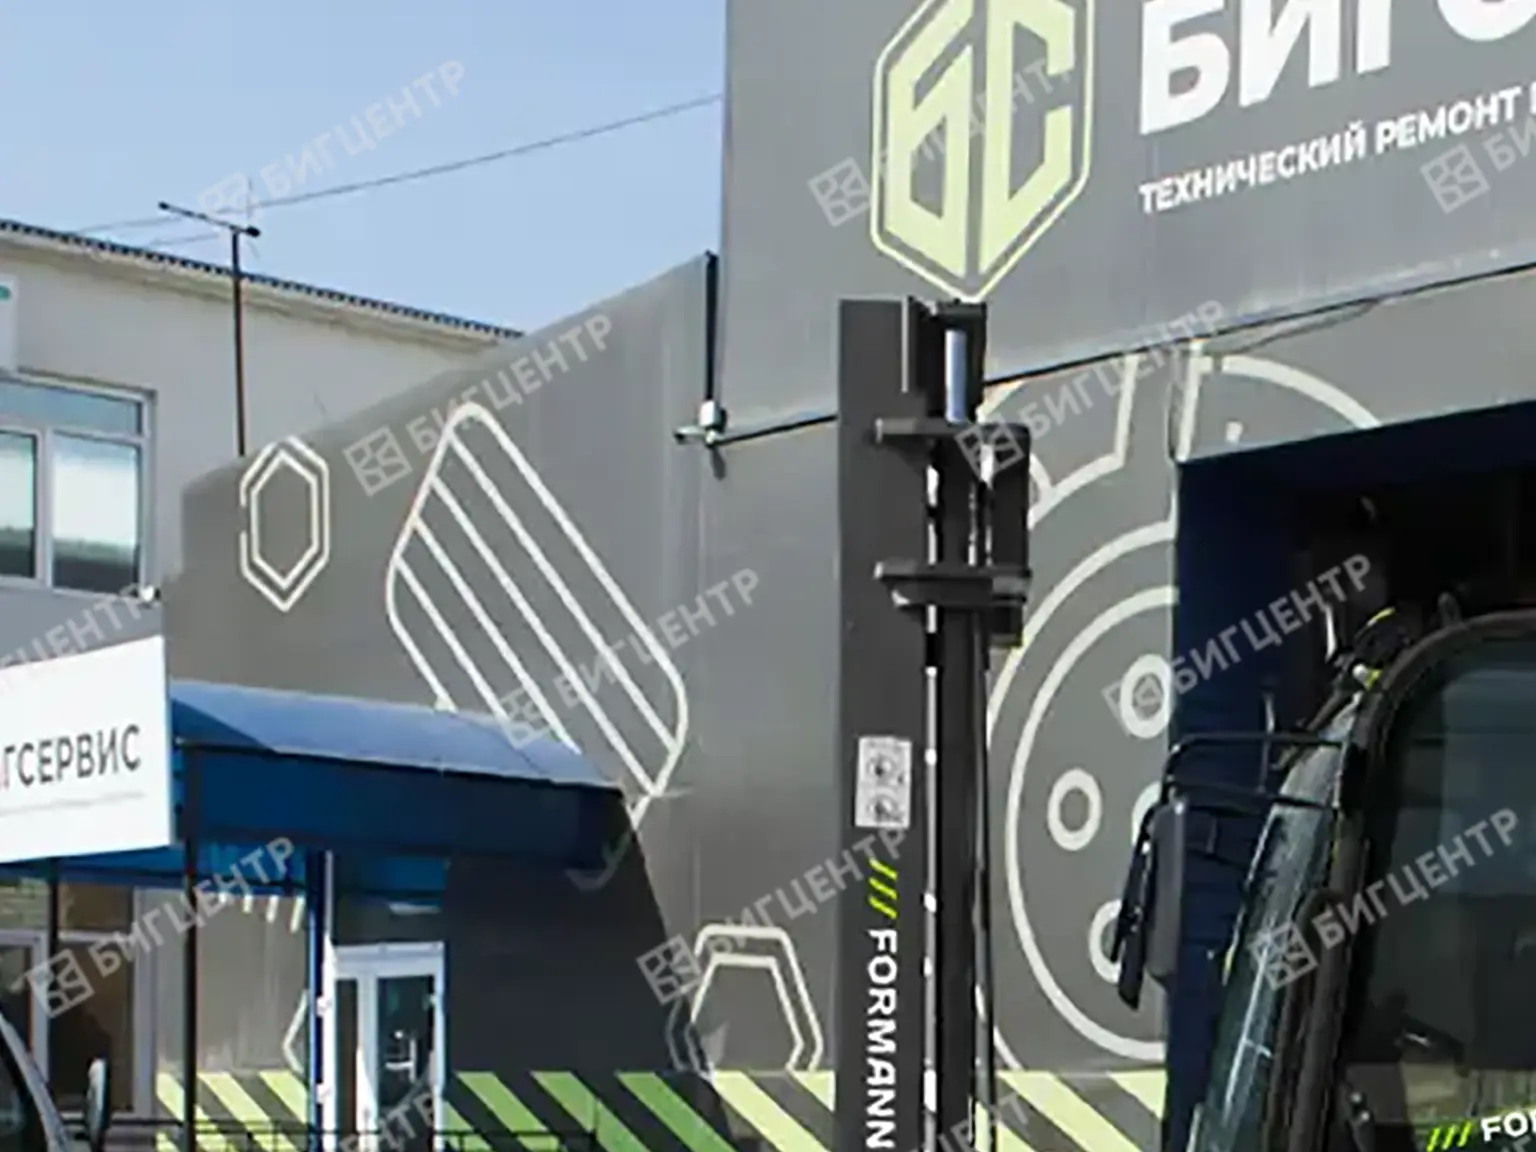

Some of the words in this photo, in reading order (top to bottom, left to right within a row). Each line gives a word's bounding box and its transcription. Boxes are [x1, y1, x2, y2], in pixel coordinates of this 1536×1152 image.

[1138, 121, 1367, 215] ТЕХНИЧЕСКИЙ
[1375, 87, 1523, 155] РЕМОНТ
[865, 929, 898, 1149] FORMANN
